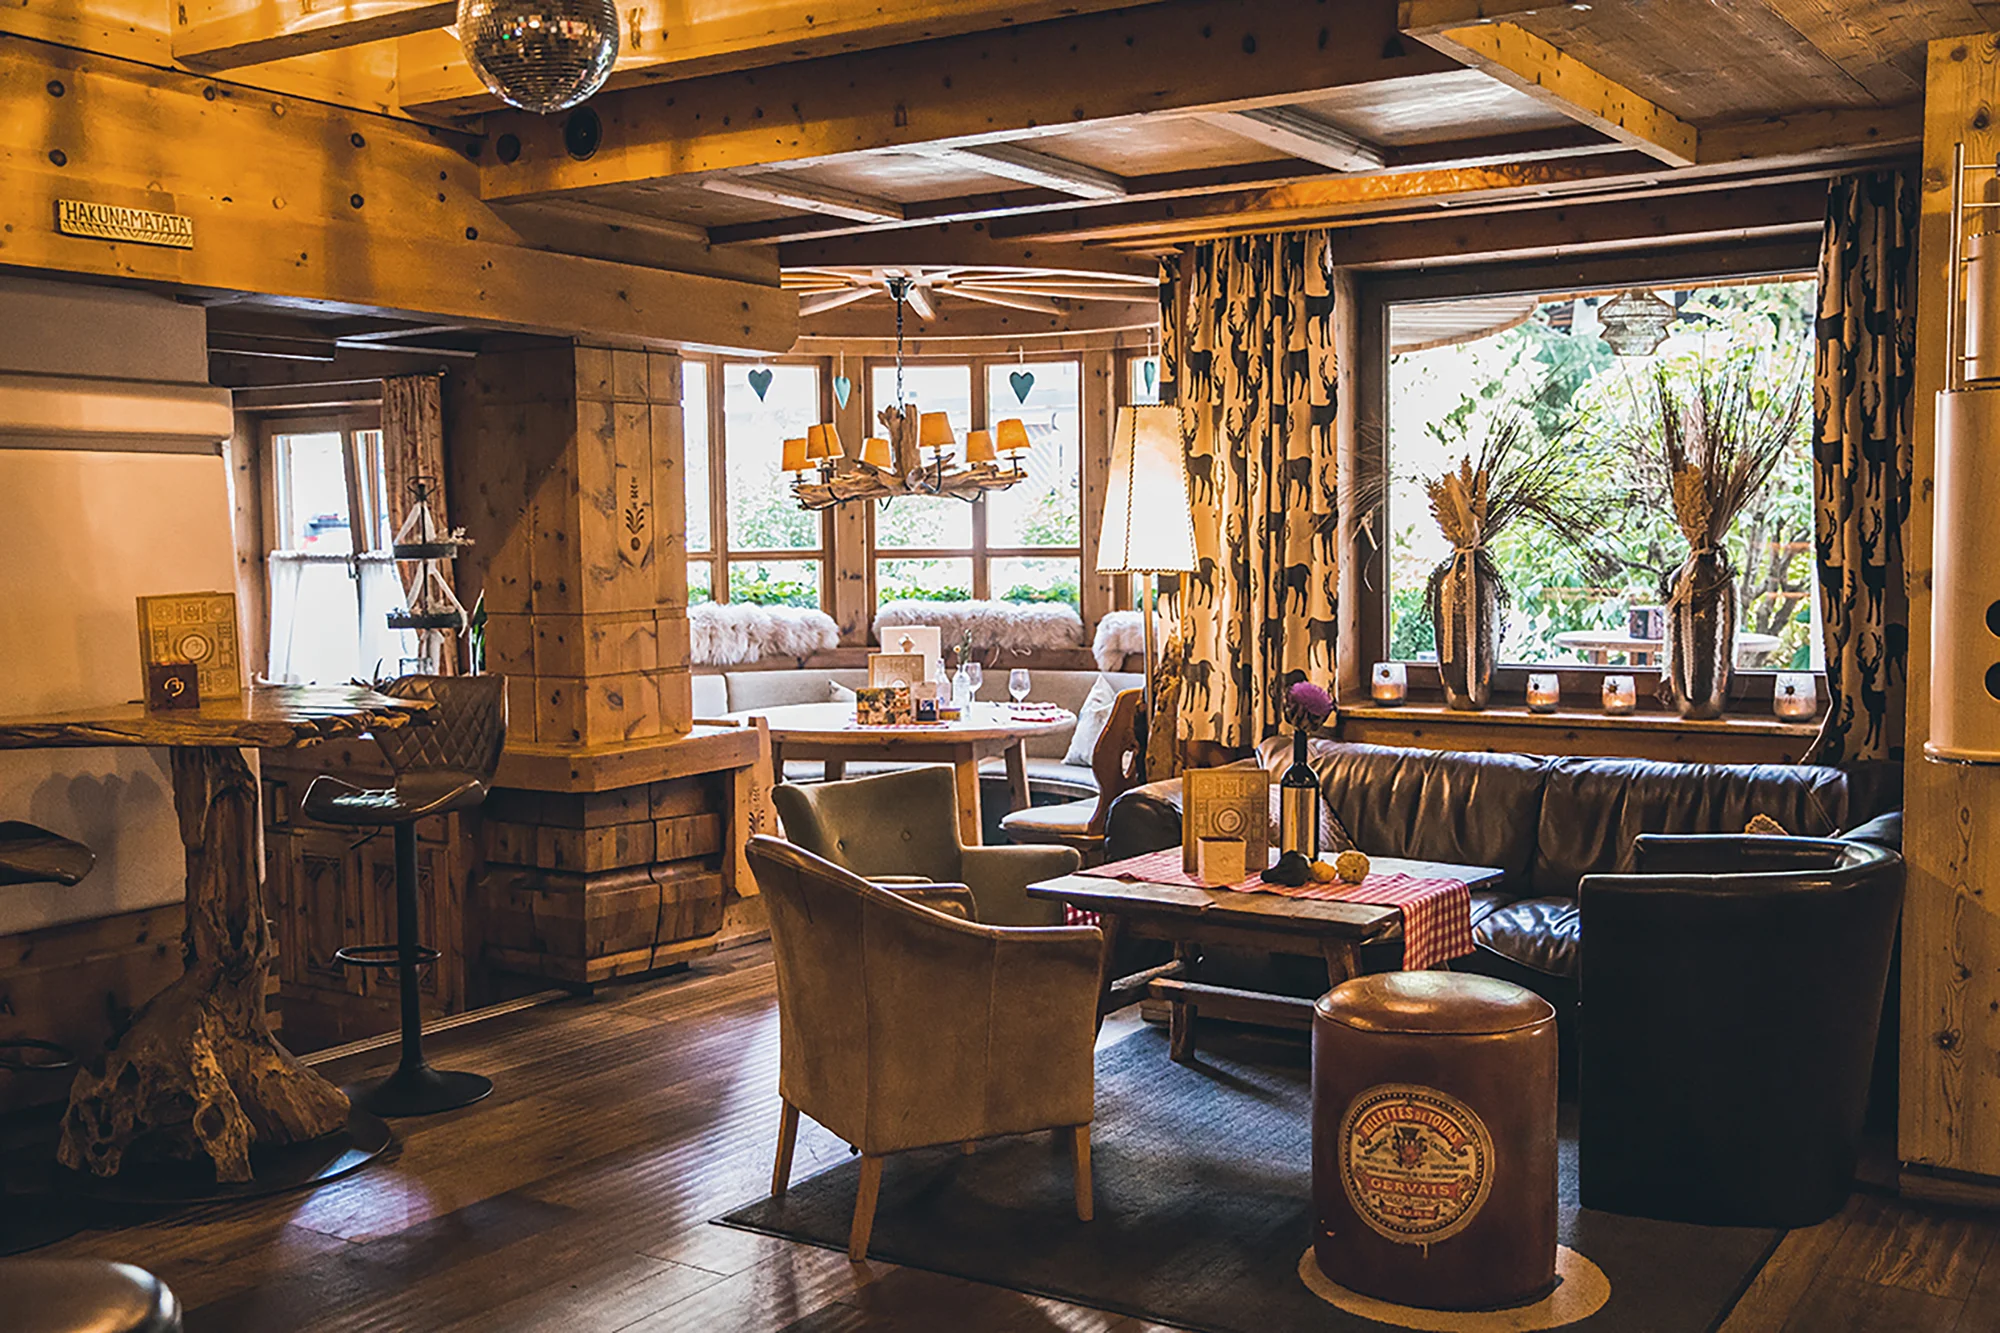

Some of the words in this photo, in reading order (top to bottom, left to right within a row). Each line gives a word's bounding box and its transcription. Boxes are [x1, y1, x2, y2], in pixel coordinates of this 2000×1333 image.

[66, 201, 188, 234] HAKUNAMATATA
[1427, 1112, 1461, 1144] TOURS
[1370, 1178, 1450, 1196] GERVAIS
